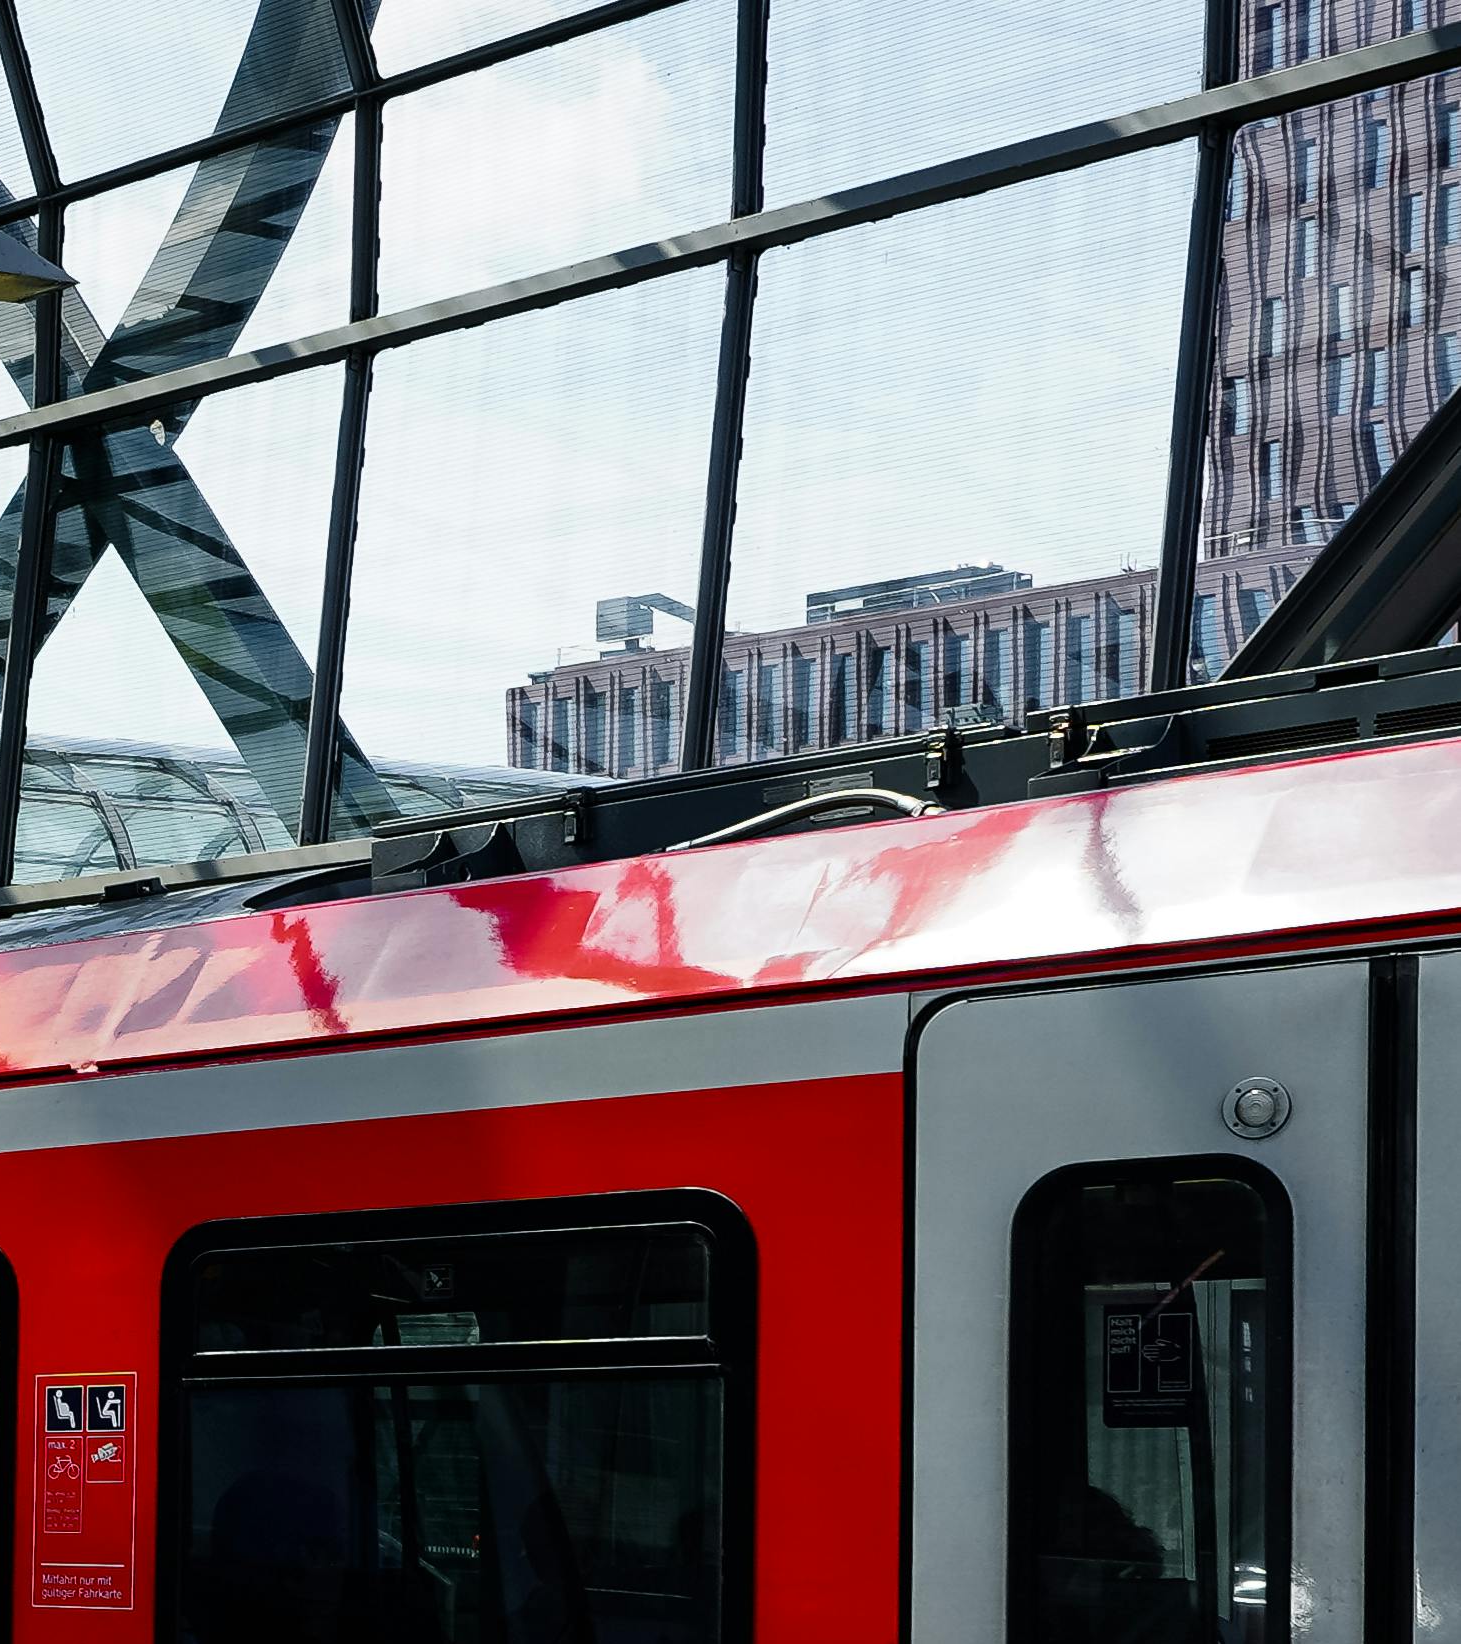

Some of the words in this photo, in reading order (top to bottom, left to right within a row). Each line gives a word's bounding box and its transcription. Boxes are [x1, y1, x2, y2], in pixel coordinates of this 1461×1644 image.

[69, 1439, 76, 1450] 2
[42, 1573, 77, 1585] Mitfahrt
[79, 1576, 95, 1585] nur
[97, 1576, 112, 1586] mit
[41, 1588, 76, 1600] gültiger
[78, 1587, 122, 1600] Fahrkarte
